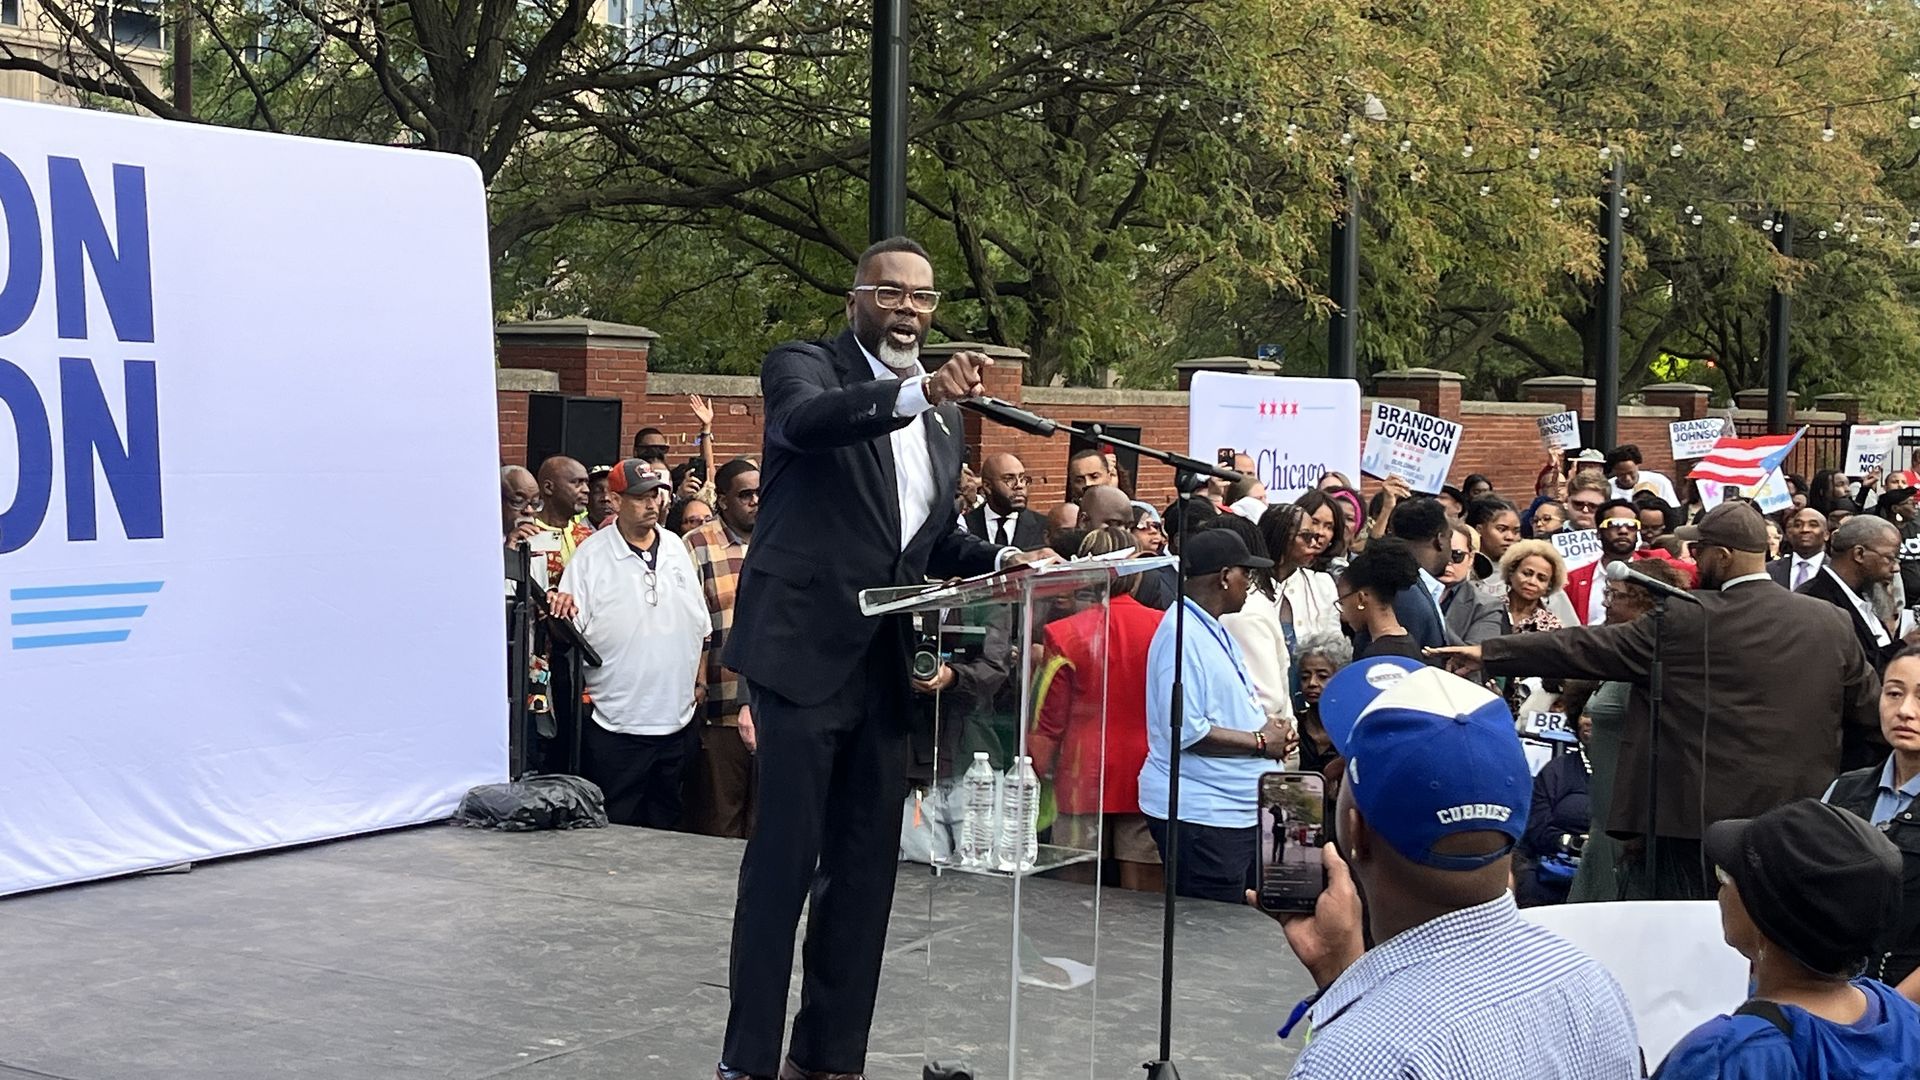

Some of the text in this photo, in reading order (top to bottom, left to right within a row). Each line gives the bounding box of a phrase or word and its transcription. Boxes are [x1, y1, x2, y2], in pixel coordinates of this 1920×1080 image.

[1378, 405, 1456, 439] BRANDON
[1673, 420, 1718, 433] BRANDO
[1375, 421, 1452, 455] JOHNSON
[1674, 429, 1719, 442] JOHNSO
[1257, 448, 1327, 490] Chicago
[1536, 713, 1563, 731] BR
[1436, 804, 1512, 824] CUBBIES
